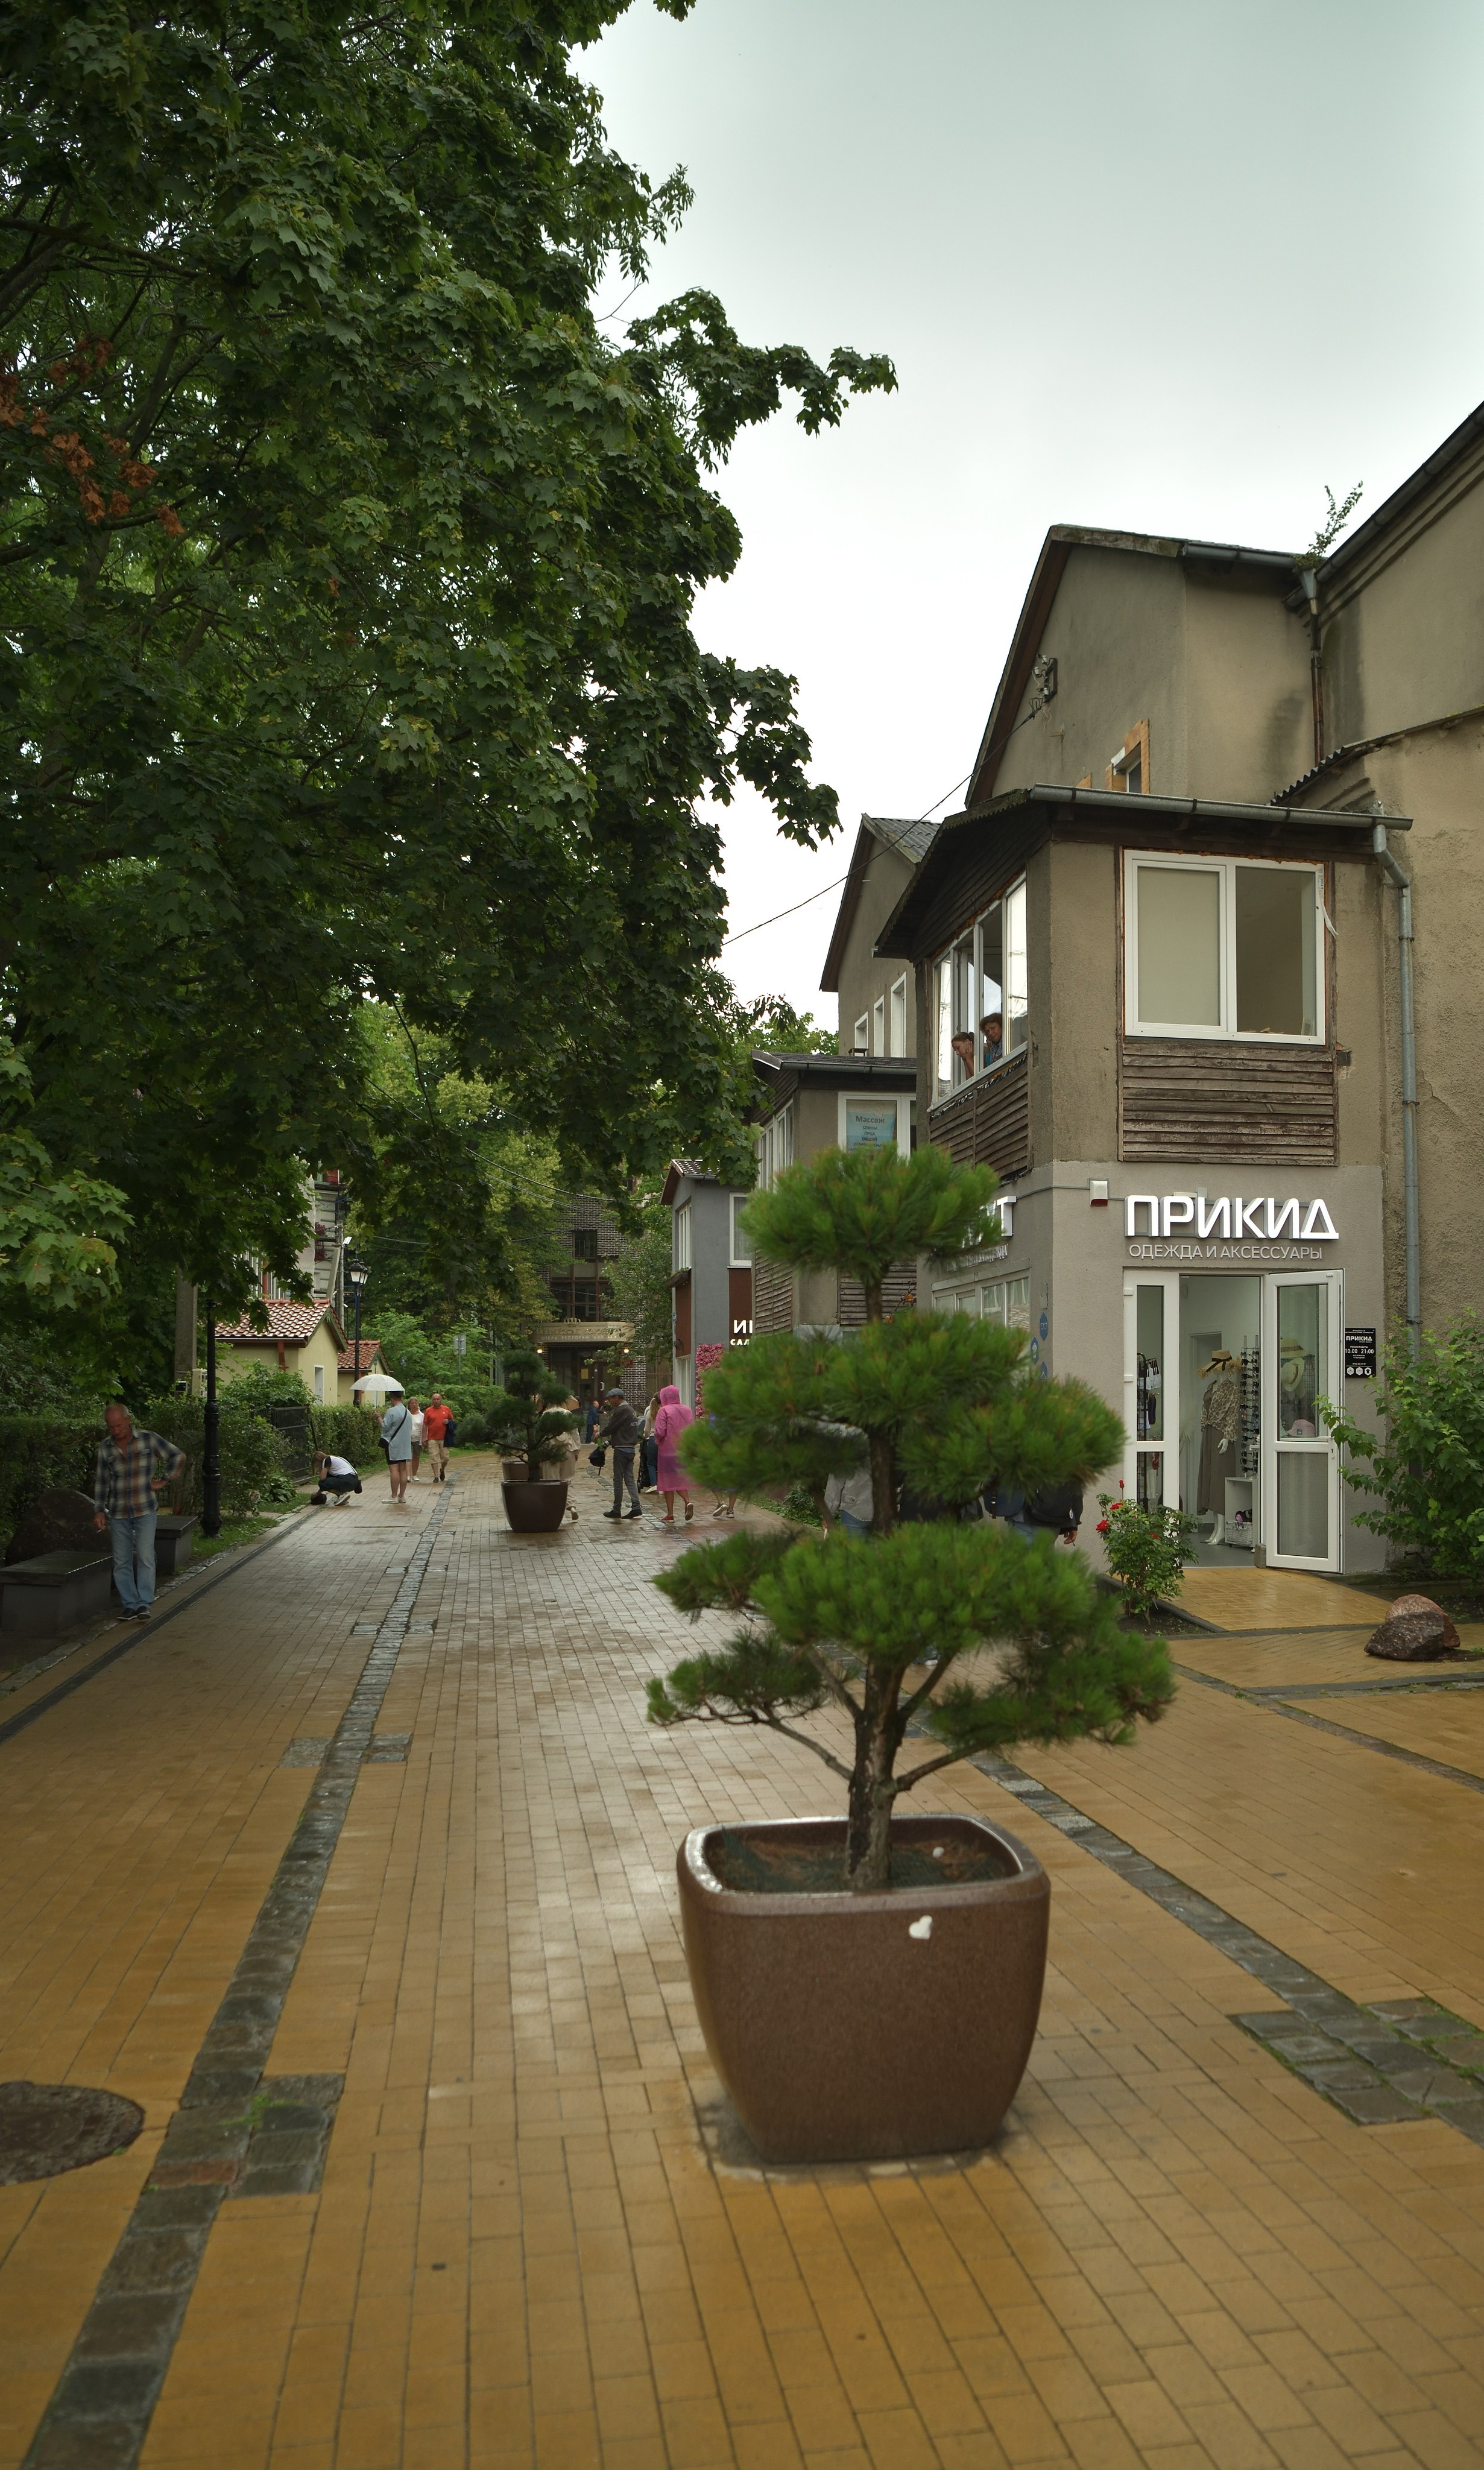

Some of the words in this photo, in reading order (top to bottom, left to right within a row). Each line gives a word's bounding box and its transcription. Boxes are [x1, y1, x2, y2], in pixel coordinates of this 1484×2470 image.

[1125, 1195, 1339, 1239] ПРИКИД
[1129, 1244, 1203, 1260] ОДЕЖДА
[1207, 1245, 1217, 1258] И
[1220, 1246, 1324, 1260] АКСЕССУАРЫ
